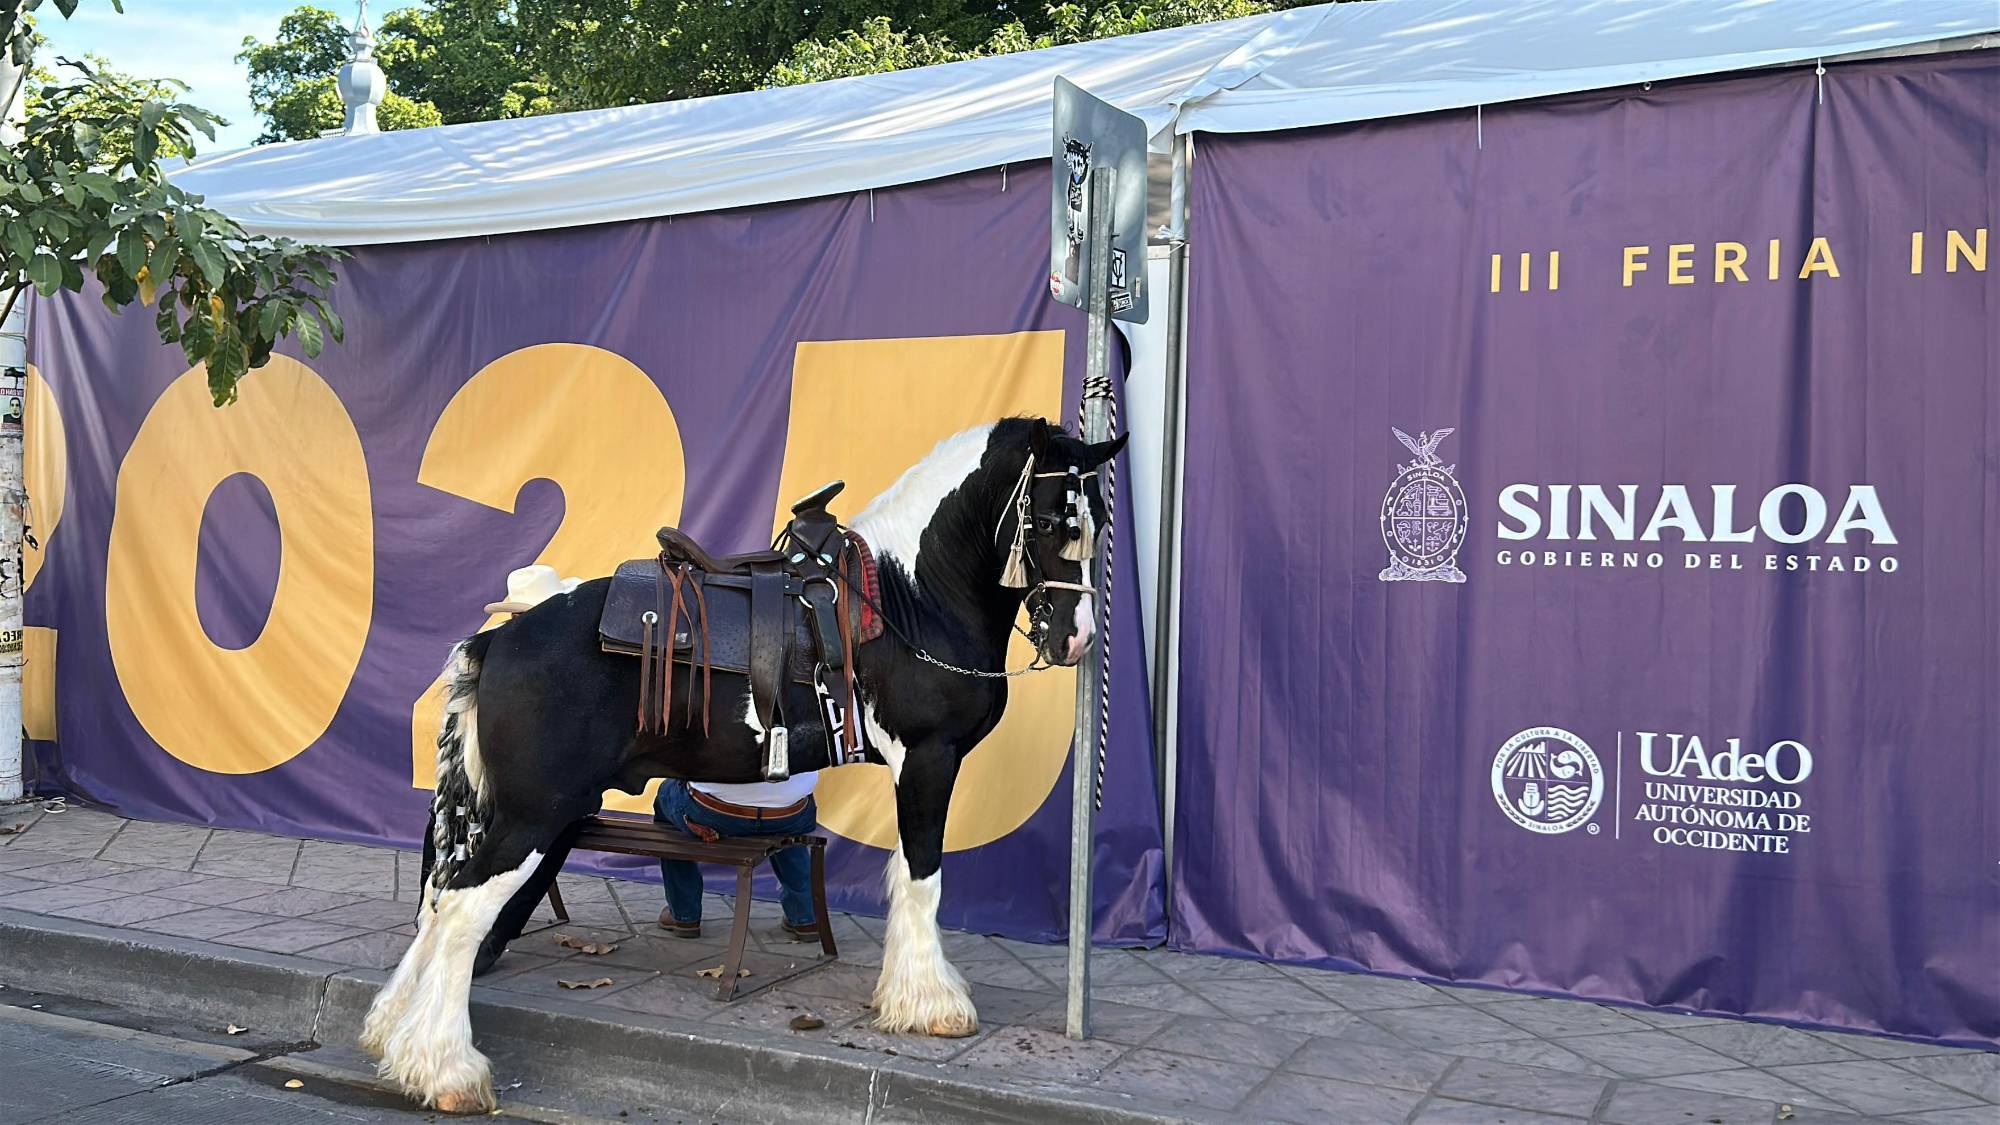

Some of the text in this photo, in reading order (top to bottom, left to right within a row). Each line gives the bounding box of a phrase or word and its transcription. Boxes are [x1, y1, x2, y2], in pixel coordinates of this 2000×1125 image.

[1490, 228, 1988, 292] III FERIA IN
[1406, 471, 1445, 482] SINALOA
[1496, 483, 1899, 545] SINALOA
[1496, 550, 1899, 573] GOBIERNO DEL ESTADO
[24, 330, 1080, 852] 025
[1495, 752, 1506, 768] POR
[1505, 743, 1515, 754] LA
[1515, 729, 1551, 743] CULTURA
[1562, 733, 1572, 742] LA
[1574, 741, 1600, 774] LIBERTAD
[1635, 731, 1814, 785] UAdeO
[1645, 782, 1802, 809] UNIVERSIDAD
[1528, 821, 1564, 832] SINALOA
[1634, 803, 1812, 833] AUTÓNOMA DE
[1653, 827, 1790, 854] OCCIDENTE
